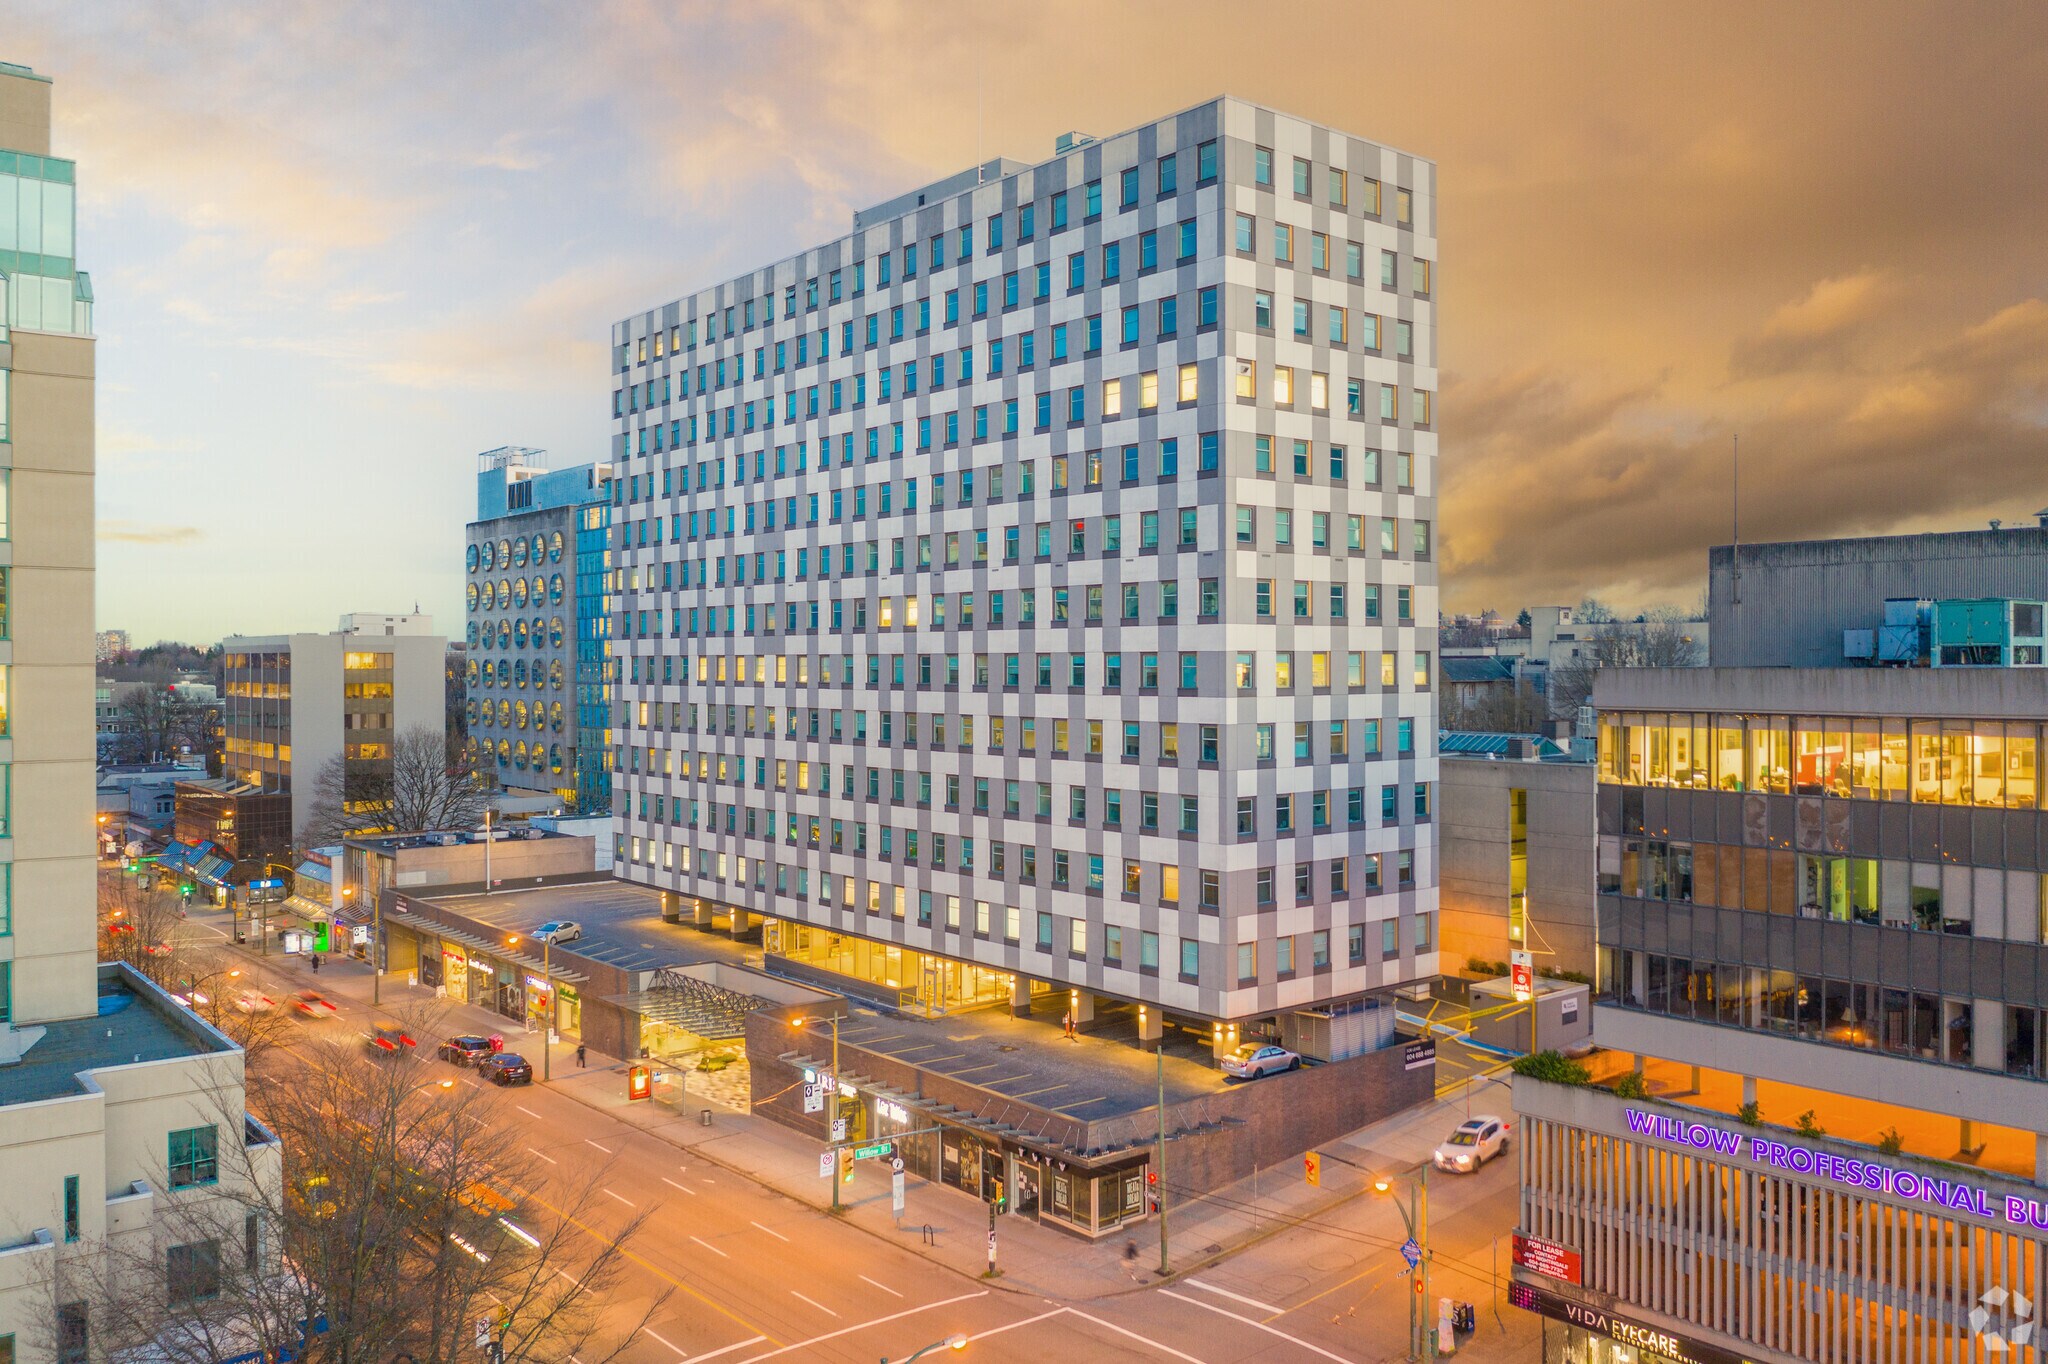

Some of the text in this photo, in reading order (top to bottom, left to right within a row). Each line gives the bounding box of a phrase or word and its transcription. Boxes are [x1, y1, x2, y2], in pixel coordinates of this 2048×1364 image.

[859, 1144, 888, 1158] Willow St
[1625, 1108, 1742, 1156] WILLOW
[1751, 1137, 1995, 1218] PROFESSIONAL
[1527, 1240, 1564, 1257] FOR LEASE
[1534, 1249, 1557, 1261] CONTACT
[1566, 1303, 1679, 1355] VIDA EYECARE
